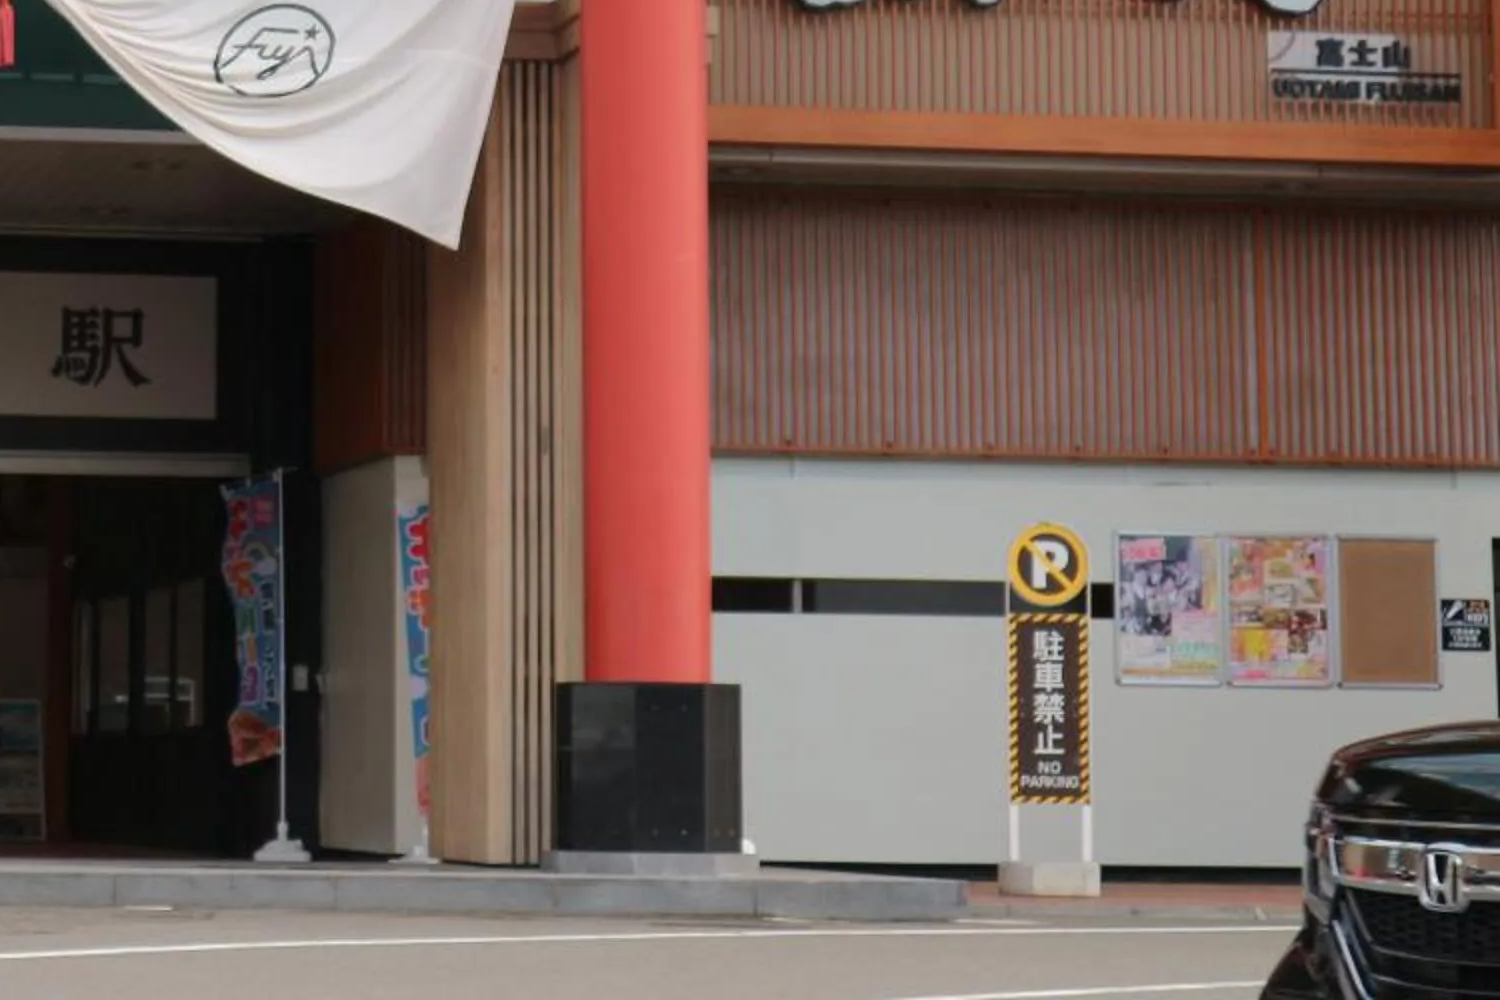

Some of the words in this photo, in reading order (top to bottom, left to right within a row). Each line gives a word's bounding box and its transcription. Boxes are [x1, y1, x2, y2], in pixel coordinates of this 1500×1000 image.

[1316, 37, 1411, 69] 富士山
[1033, 630, 1065, 755] 駐車禁止
[1037, 760, 1062, 775] NO
[1020, 775, 1079, 789] PARKING
